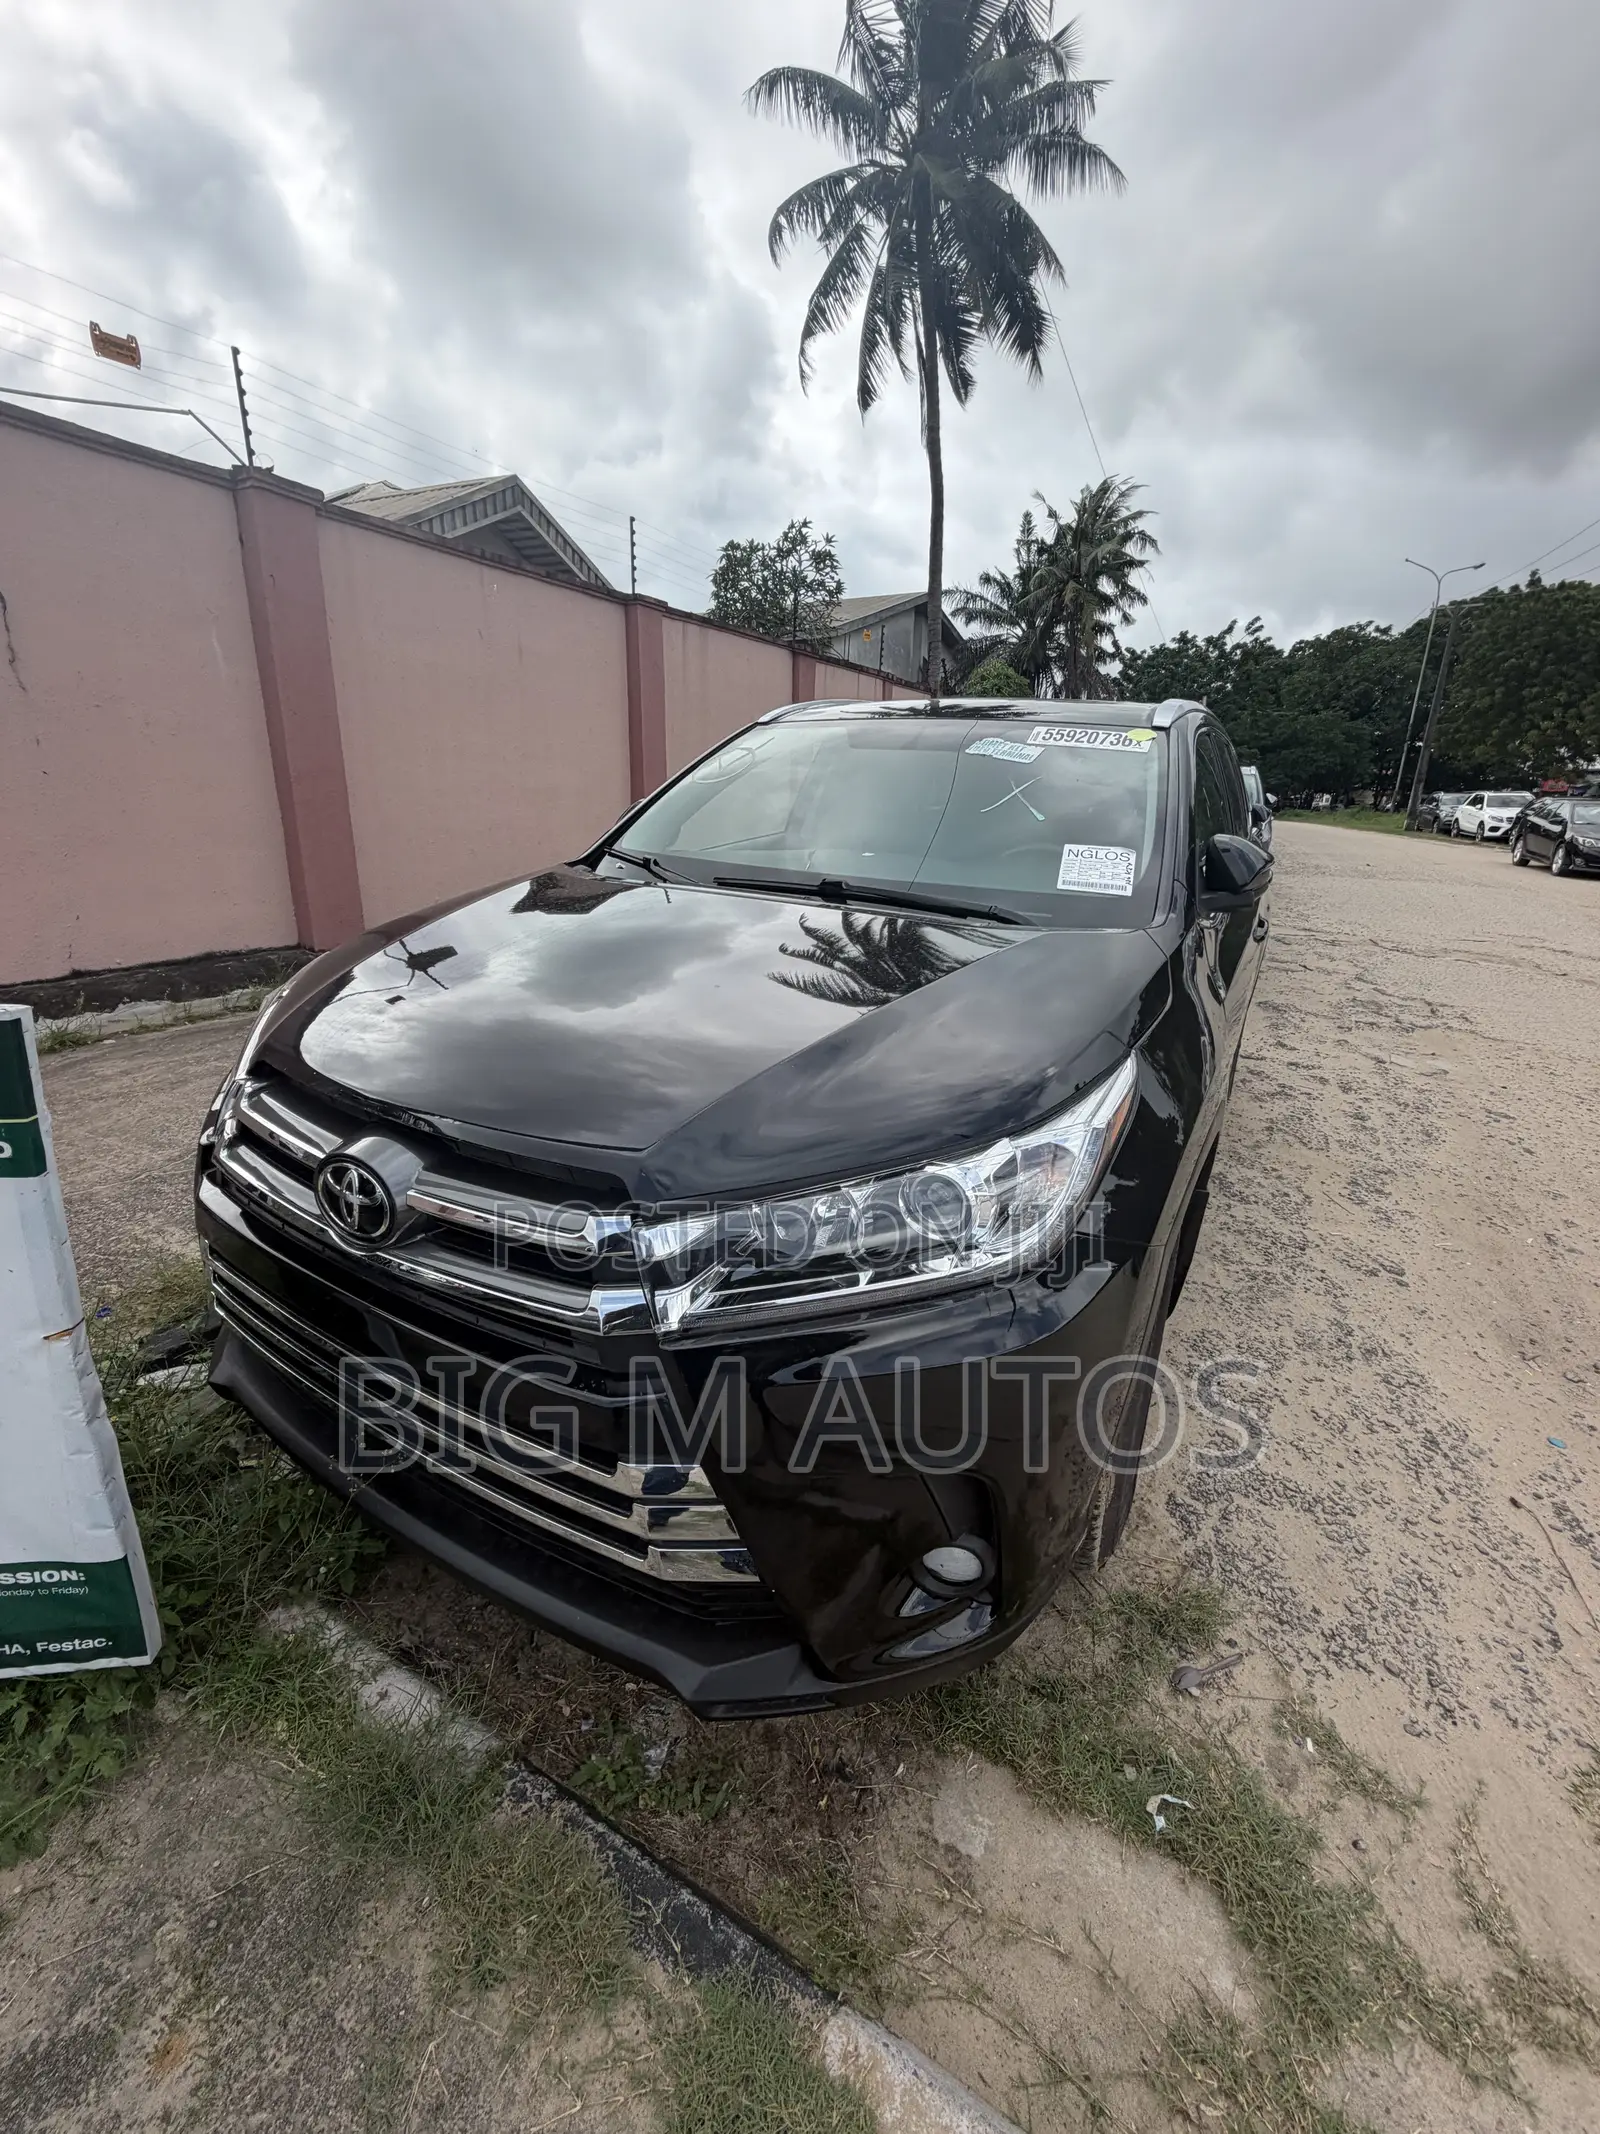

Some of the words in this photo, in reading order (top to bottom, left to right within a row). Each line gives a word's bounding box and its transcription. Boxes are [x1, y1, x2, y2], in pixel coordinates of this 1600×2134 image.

[1042, 728, 1133, 747] 55920736
[1067, 848, 1131, 862] NGLOS
[0, 1588, 36, 1597] onday
[38, 1587, 49, 1595] to
[52, 1586, 89, 1596] Friday)
[36, 1637, 113, 1653] Festac.
